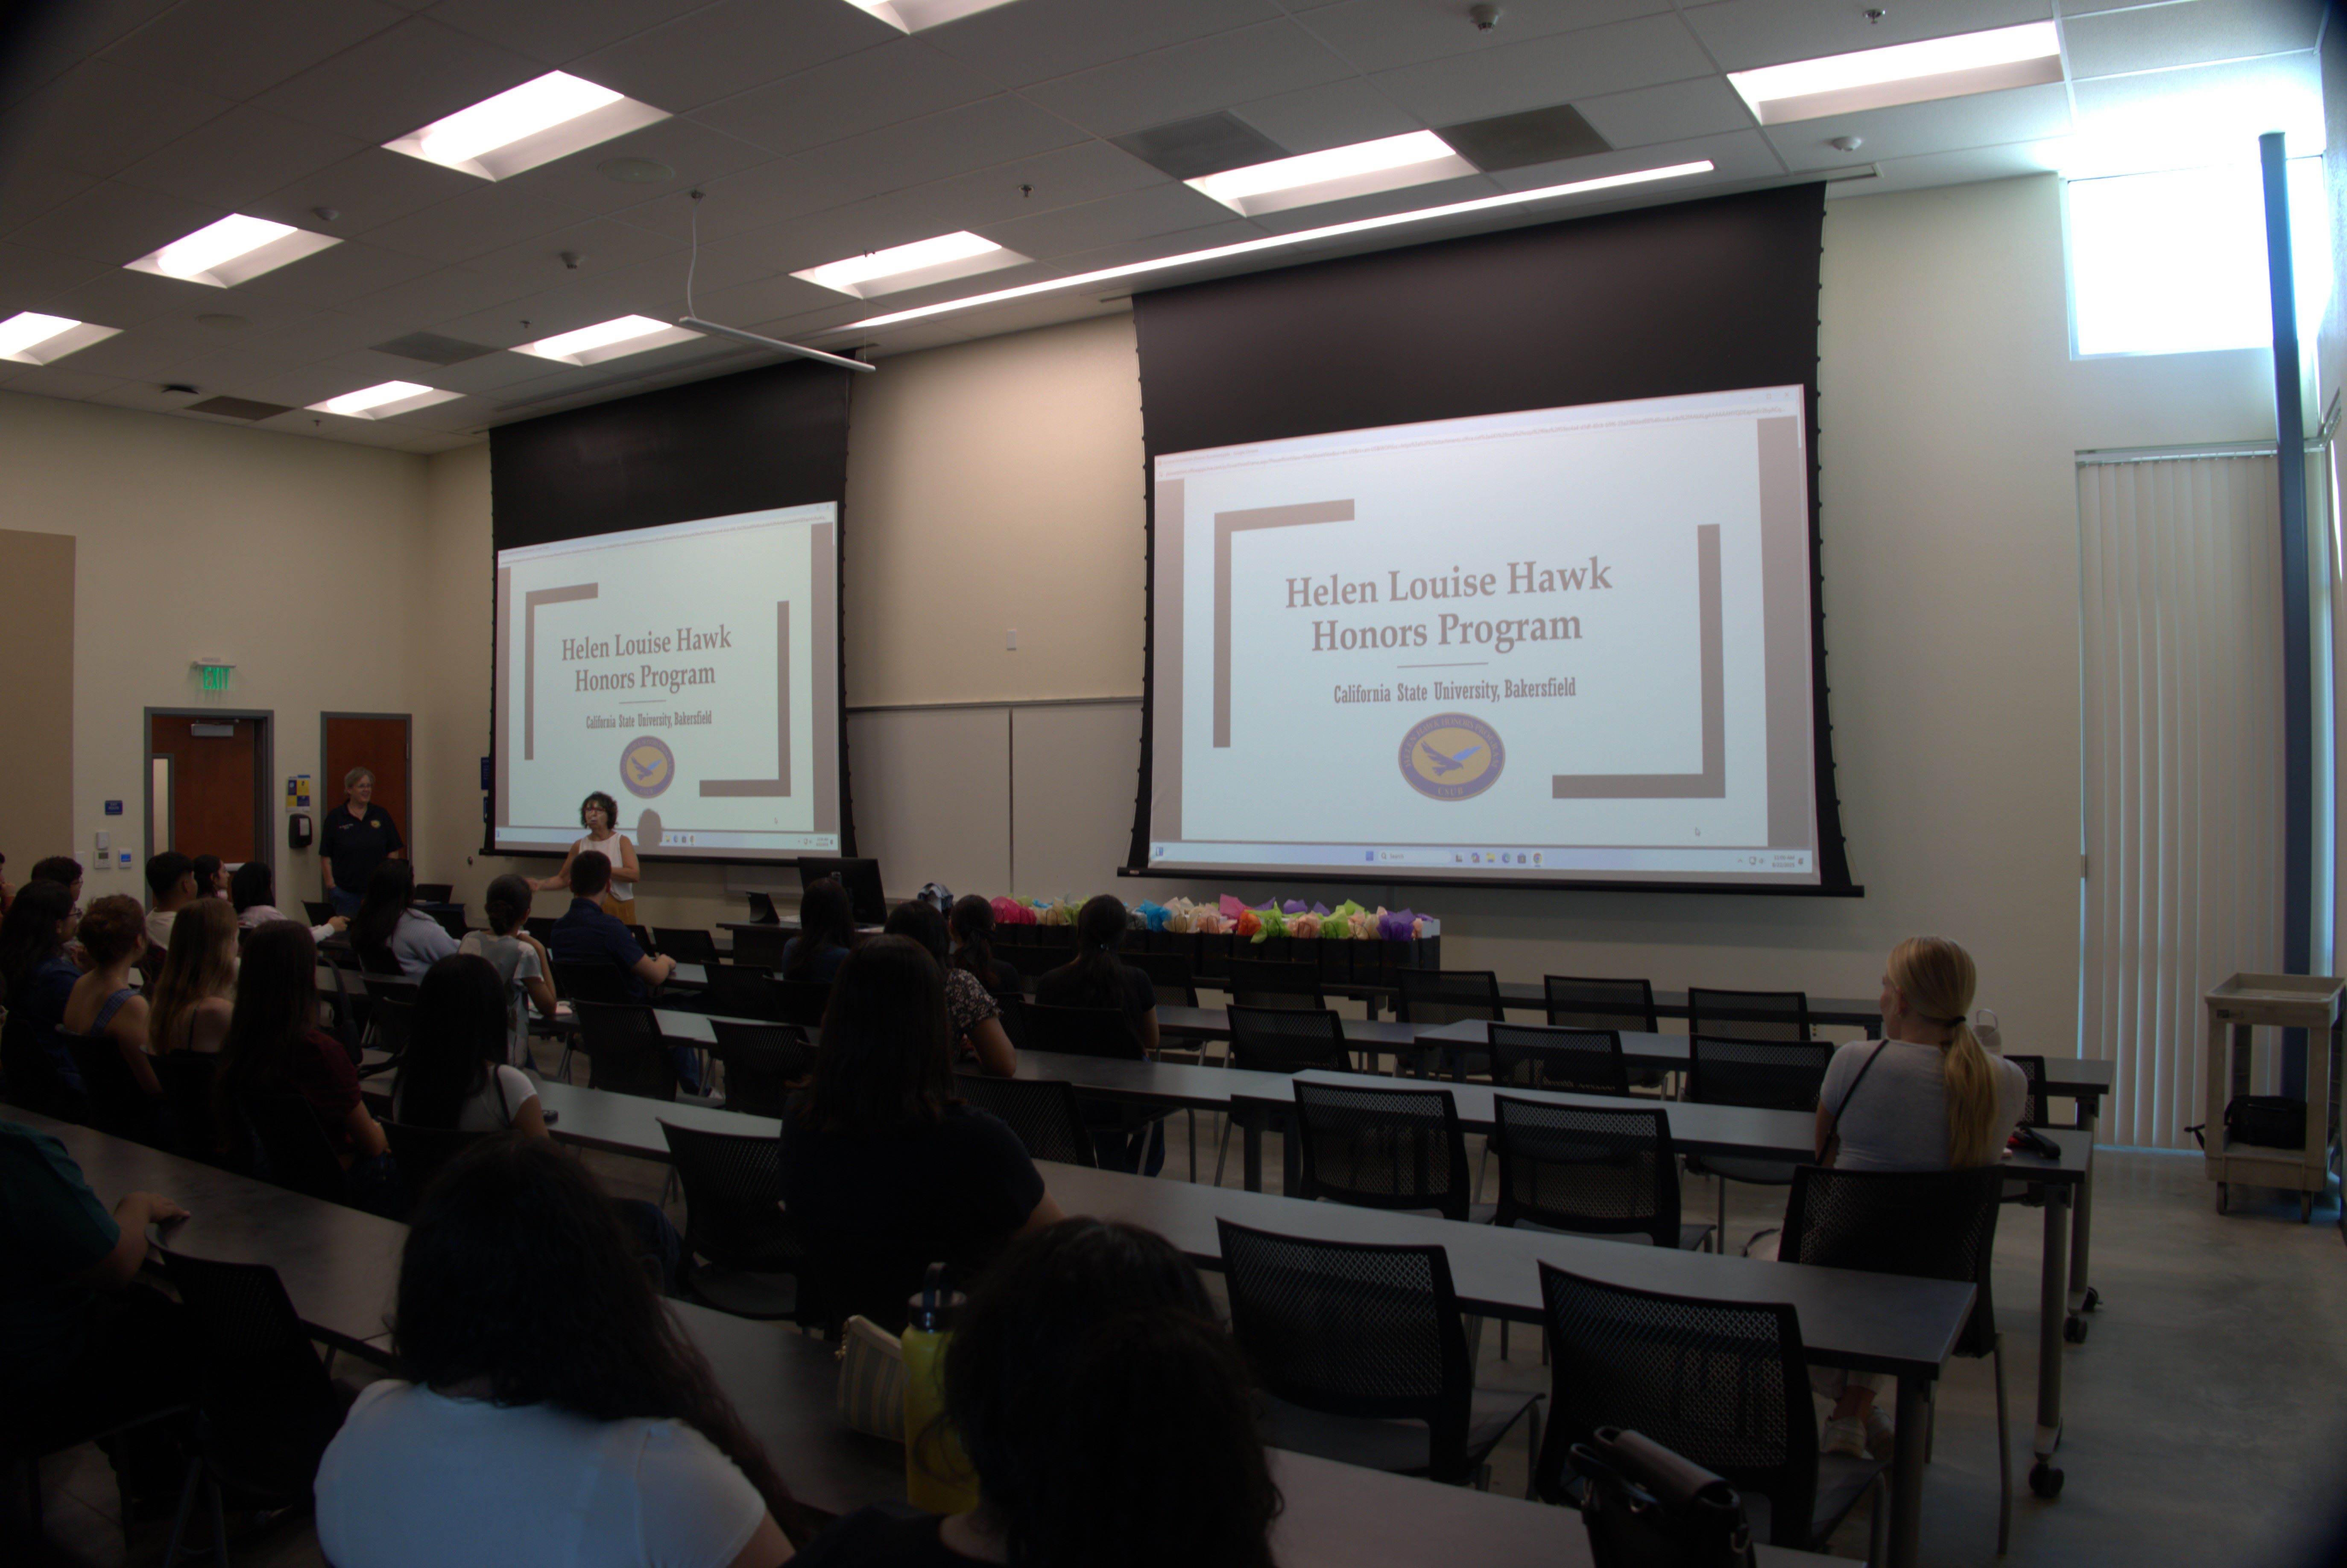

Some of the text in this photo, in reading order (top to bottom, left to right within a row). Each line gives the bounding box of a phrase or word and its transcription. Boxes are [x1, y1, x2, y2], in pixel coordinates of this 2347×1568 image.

[1286, 556, 1612, 608] Helen Louise Hawk
[562, 624, 732, 661] Helen Louise Hawk
[1312, 614, 1583, 654] Honors Program
[204, 667, 230, 690] EXIT
[576, 665, 715, 694] Honors Program
[1334, 677, 1576, 704] California State University, Bakersfield
[586, 711, 712, 729] California State University, Bakersfield
[1441, 717, 1473, 727] HONORS
